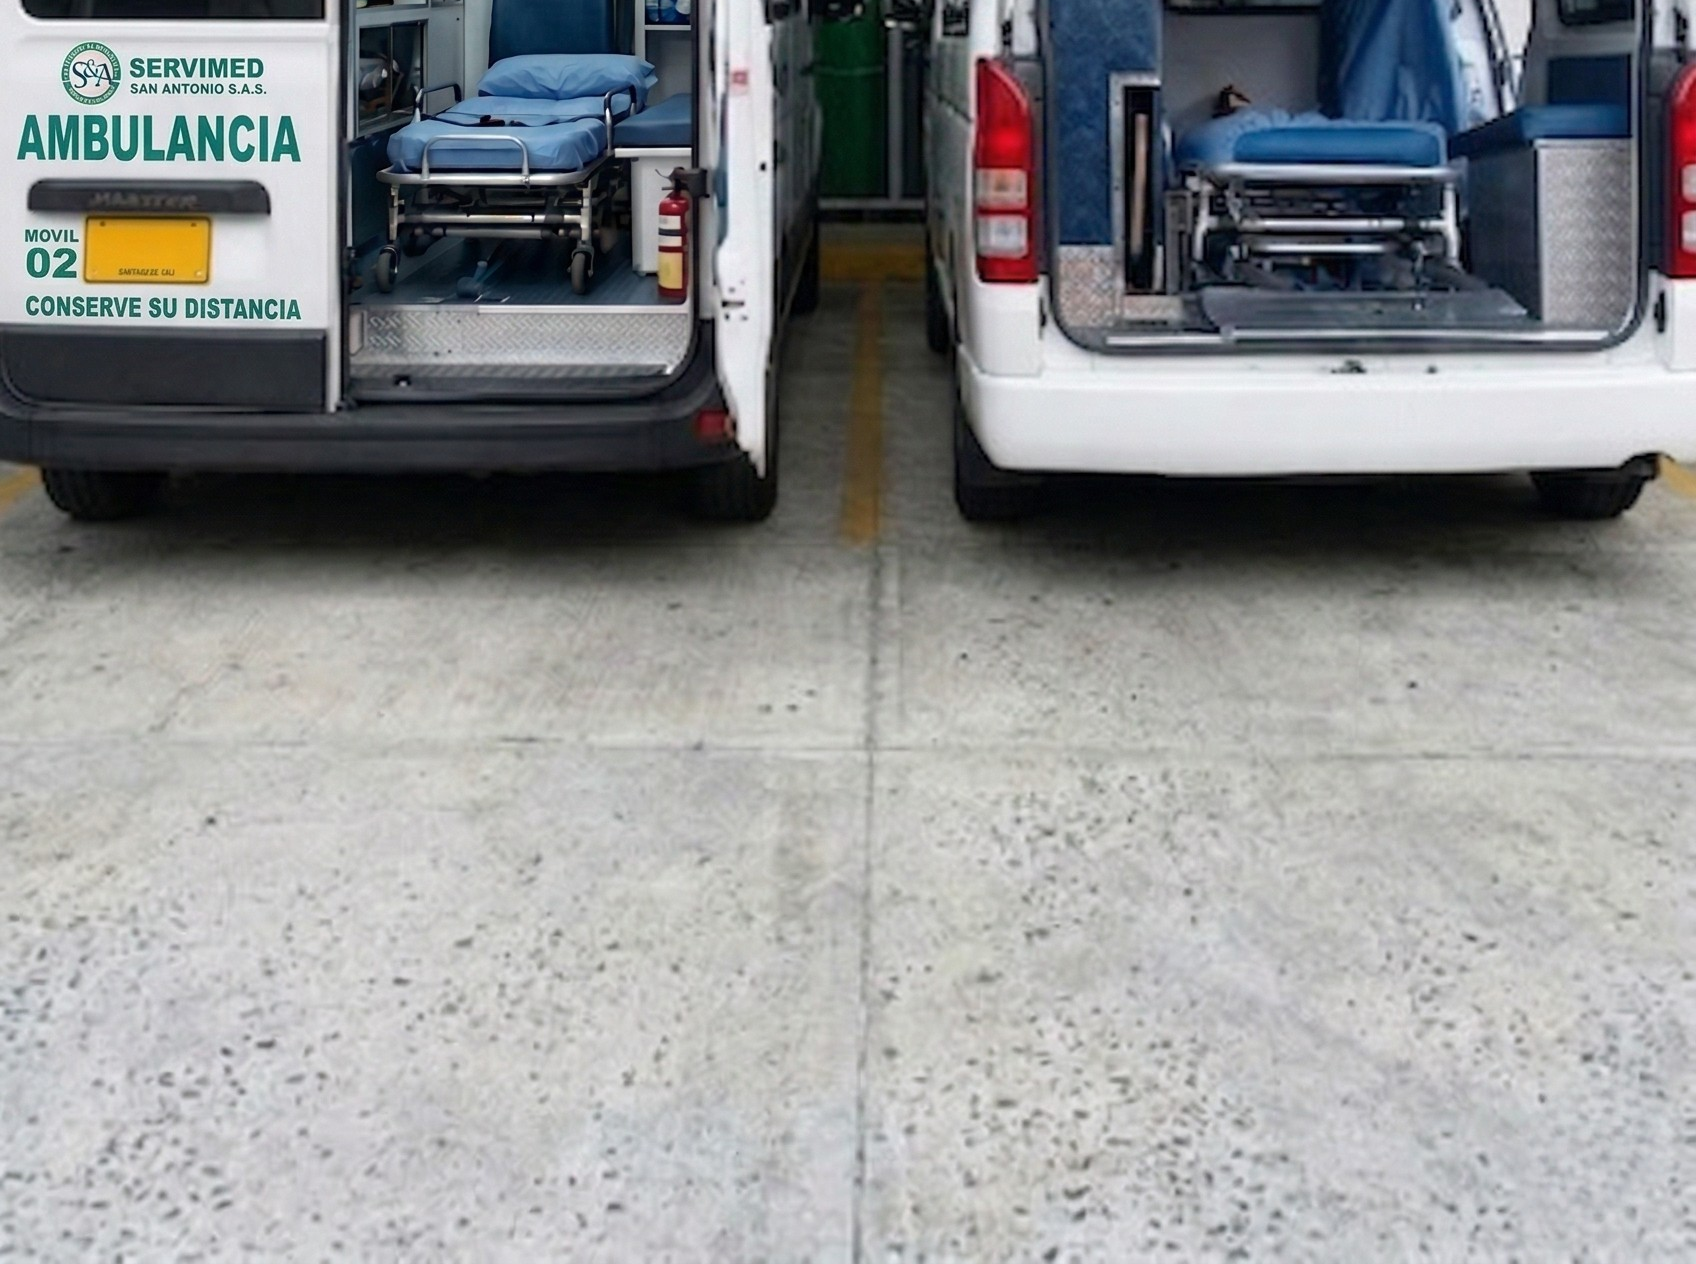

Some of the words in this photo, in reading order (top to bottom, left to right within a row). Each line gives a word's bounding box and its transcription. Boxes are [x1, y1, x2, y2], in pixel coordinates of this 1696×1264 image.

[129, 57, 264, 78] SERVIMED
[130, 84, 158, 95] SAN
[163, 83, 223, 95] ANTONIO
[228, 83, 267, 95] S.A.S.
[16, 114, 302, 163] AMBULANCIA
[24, 229, 79, 243] MOVIL
[25, 247, 77, 279] 02
[25, 295, 141, 318] CONSERVE
[148, 296, 178, 318] SU
[185, 298, 302, 321] DISTANCIA
